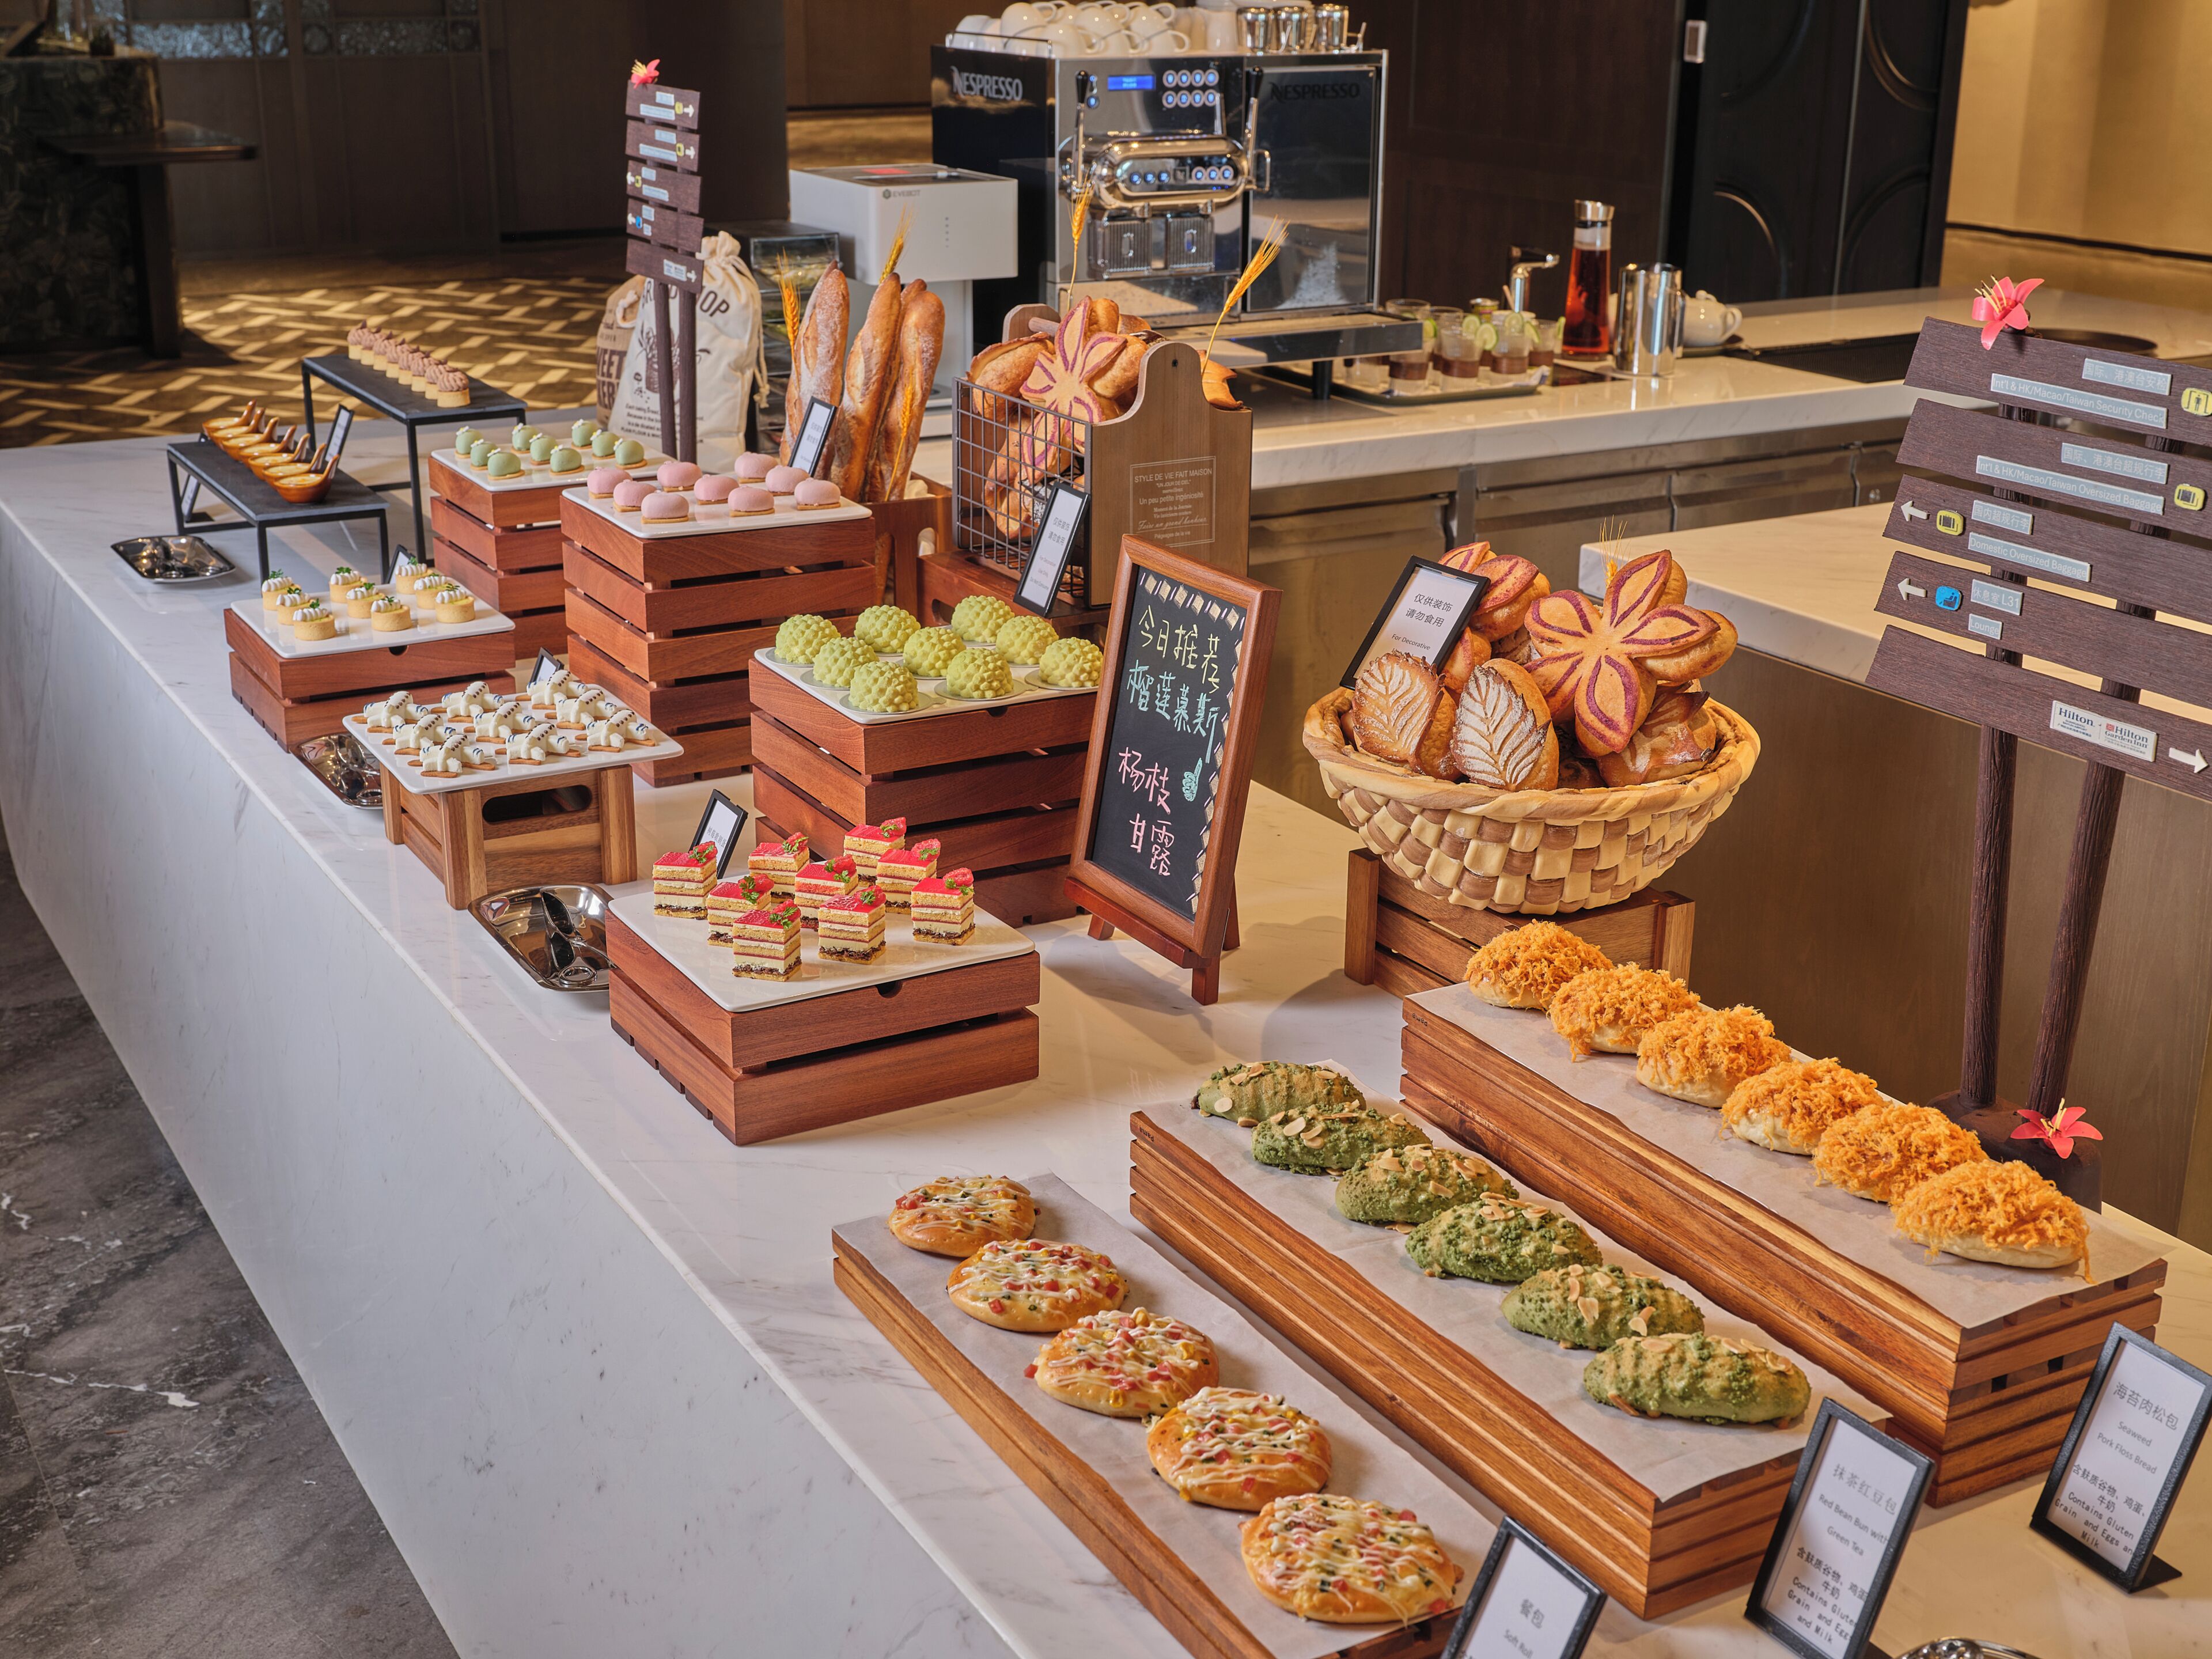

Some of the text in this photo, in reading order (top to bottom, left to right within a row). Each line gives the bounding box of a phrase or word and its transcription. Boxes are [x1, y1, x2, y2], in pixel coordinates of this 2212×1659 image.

[950, 65, 1023, 101] NESPRESSO
[1268, 82, 1360, 104] NESPRESSO
[699, 290, 729, 317] OP
[2084, 363, 2168, 391] 国际、港澳台安检
[1993, 377, 2165, 425] Int'l & HK/Macao/Taiwan Security Check
[1134, 474, 1153, 483] STYLE
[1189, 468, 1212, 477] MAISON
[2063, 447, 2166, 478] 国际、港澳台超规行李
[1160, 495, 1175, 504] petite
[1978, 460, 2162, 513] Int'l & HK/Macao/Taiwan Oversized Baggage
[1974, 505, 2029, 530] 国内超规行李
[1970, 538, 2087, 578] Domestic Oversized Baggage
[1414, 593, 1453, 612] 仅供装饰
[1972, 586, 2020, 608] 休息室 L31
[1405, 608, 1445, 627] 请勿食用
[1970, 619, 1999, 635] Lounge
[1138, 605, 1221, 694] 今日推荐
[1402, 637, 1431, 650] Decorative
[1127, 660, 1221, 764] 榴莲慕斯
[2059, 707, 2093, 726] Hilton
[2105, 730, 2133, 744] Garden
[2134, 740, 2147, 748] Inn
[2115, 726, 2148, 743] Hilton
[1119, 747, 1171, 815] 杨枝
[1129, 813, 1175, 876] 甘露
[2113, 1381, 2179, 1431] 海苔肉松包
[2118, 1421, 2152, 1447] Seaweed
[2097, 1432, 2157, 1474] Pork Floss Bread
[1832, 1464, 1897, 1516] 抹茶红豆包
[2097, 1495, 2116, 1513] 牛奶
[1819, 1494, 1834, 1509] Red
[1834, 1504, 1853, 1522] Bean
[1854, 1517, 1869, 1533] Bun
[2055, 1498, 2077, 1518] Grain
[2084, 1520, 2099, 1532] and
[2101, 1529, 2120, 1547] Eggs
[2069, 1491, 2134, 1540] Contains Gluten
[1827, 1525, 1864, 1556] Green Tea
[2081, 1531, 2100, 1549] Milk
[1793, 1577, 1857, 1627] Contains Glute
[1821, 1581, 1840, 1600] 牛奶
[1787, 1589, 1810, 1612] Grain
[1817, 1613, 1832, 1627] and
[1503, 1629, 1518, 1648] Soft
[1797, 1615, 1834, 1644] and Milk
